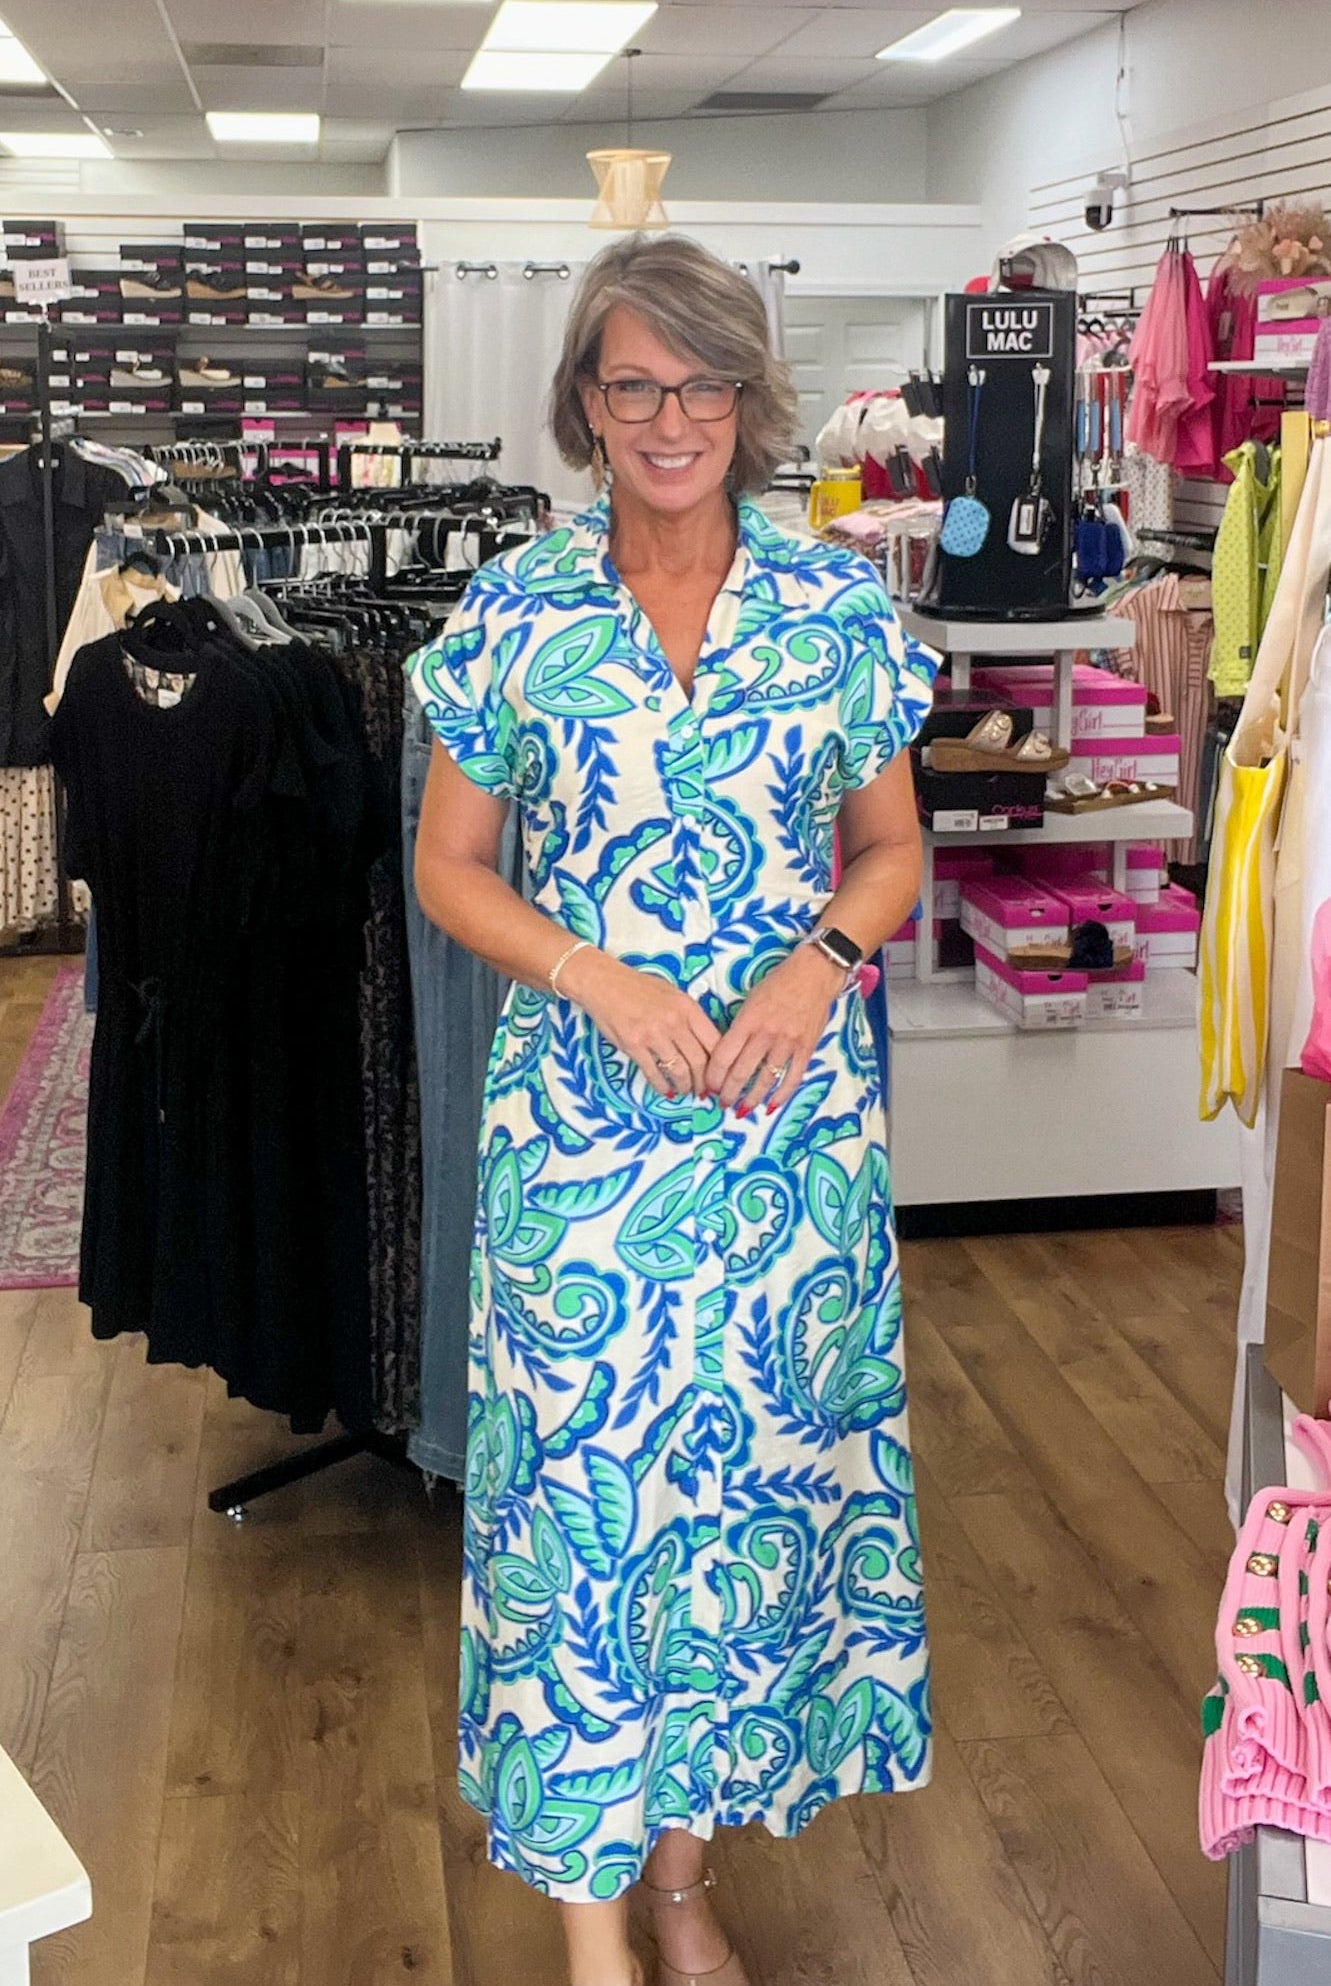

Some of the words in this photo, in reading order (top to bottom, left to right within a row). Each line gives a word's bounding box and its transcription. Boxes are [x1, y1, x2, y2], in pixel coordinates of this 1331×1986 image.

[28, 268, 56, 279] BEST
[19, 281, 69, 291] SELLERS
[982, 310, 1038, 330] LULU
[987, 331, 1033, 352] MAC
